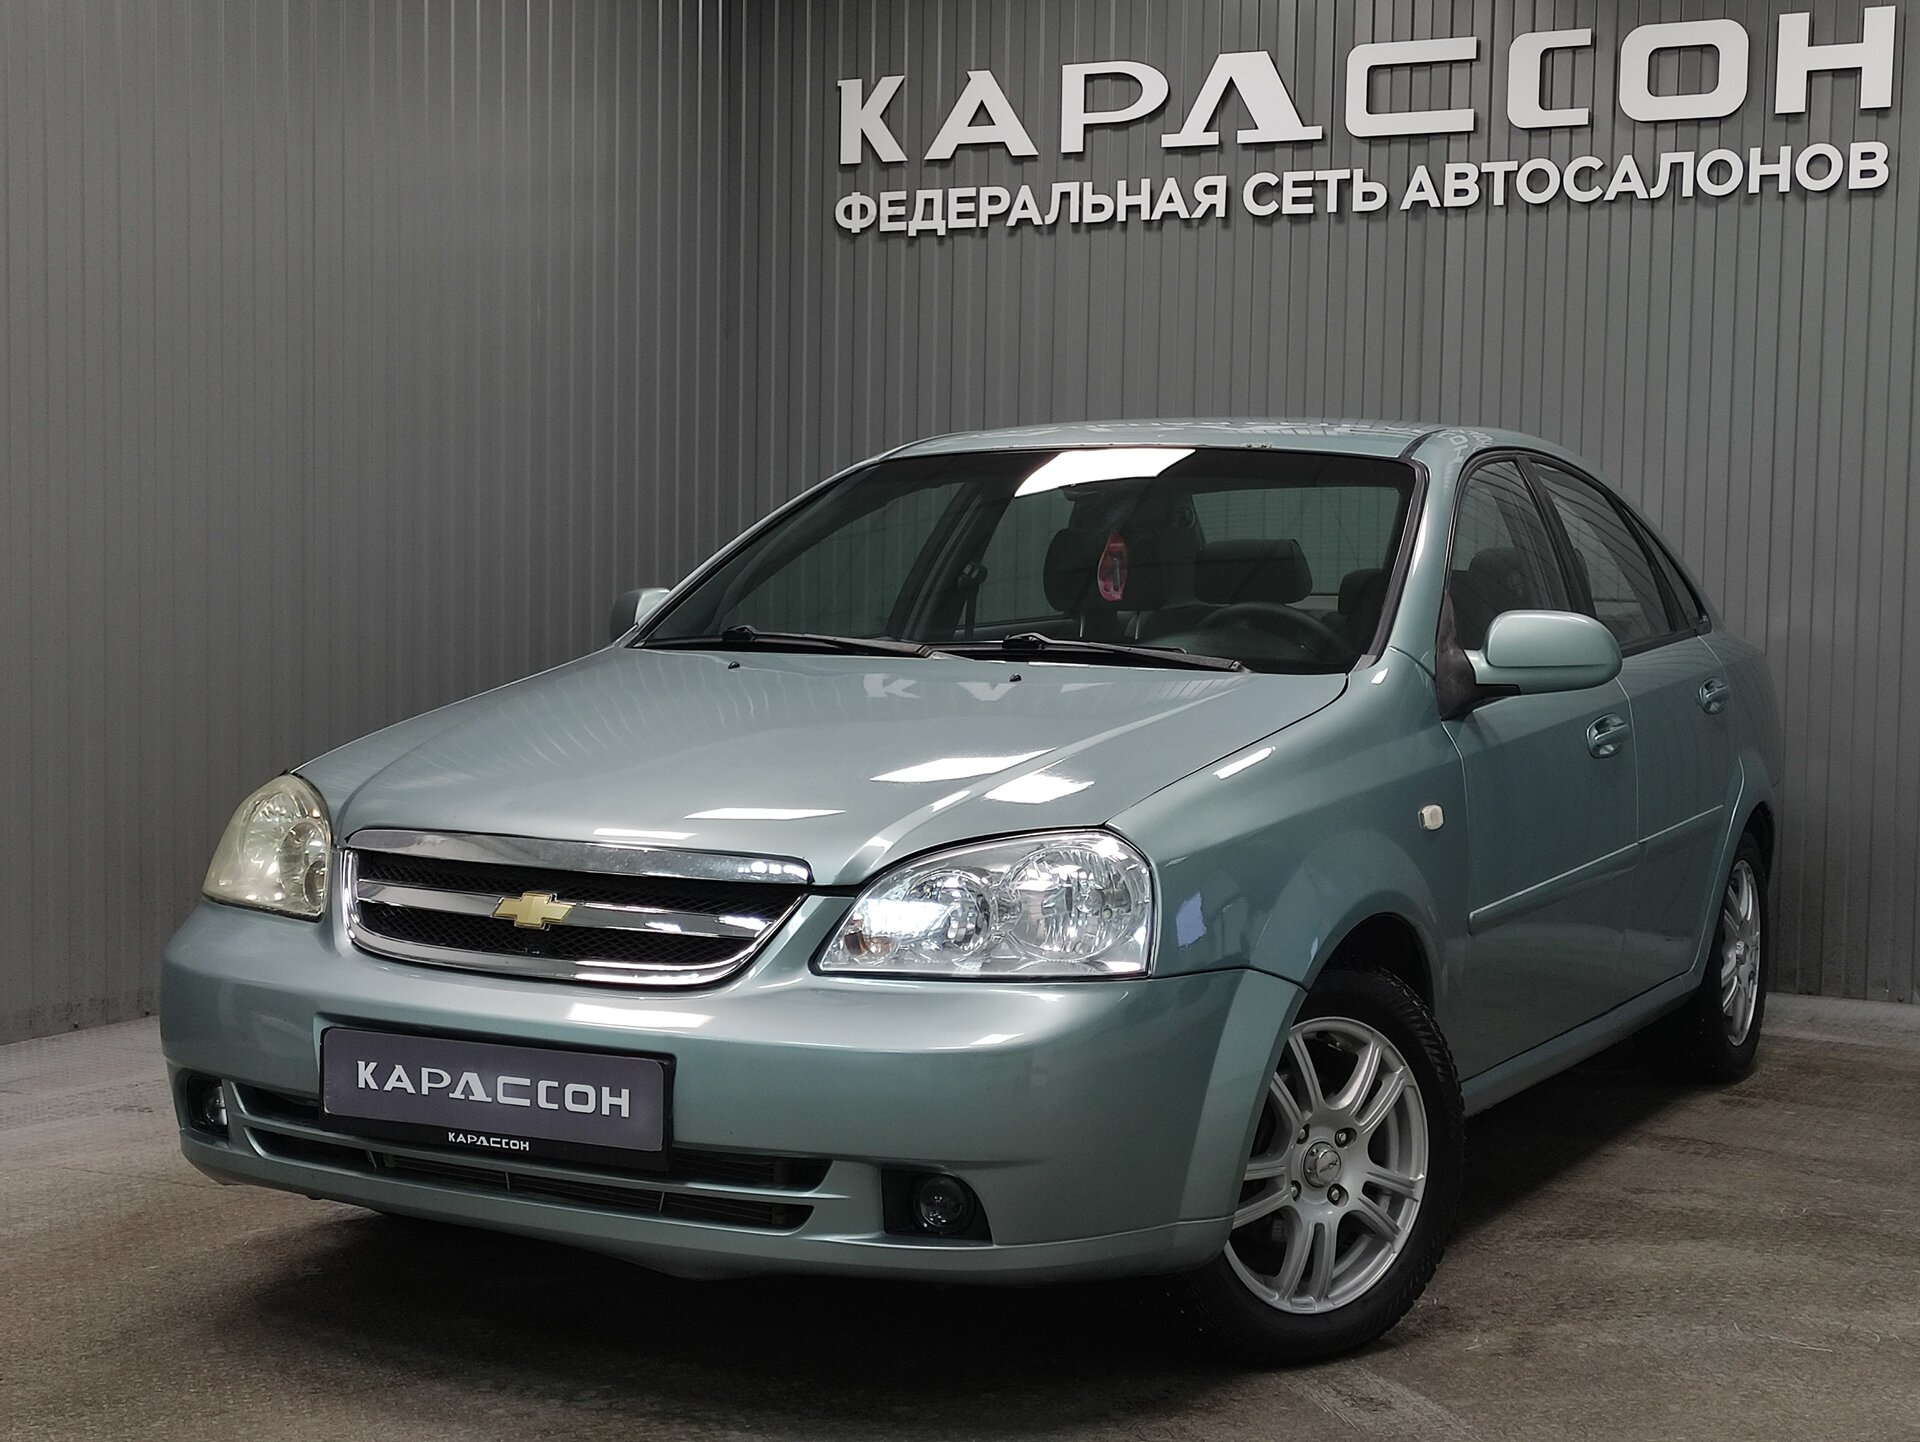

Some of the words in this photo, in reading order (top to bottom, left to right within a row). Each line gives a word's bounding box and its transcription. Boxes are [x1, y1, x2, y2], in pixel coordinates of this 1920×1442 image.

[835, 175, 1227, 236] ФЕДЕРАЛЬНАЯ
[1242, 168, 1387, 217] СЕТЬ
[1400, 141, 1890, 210] АВТОСАЛОНОВ
